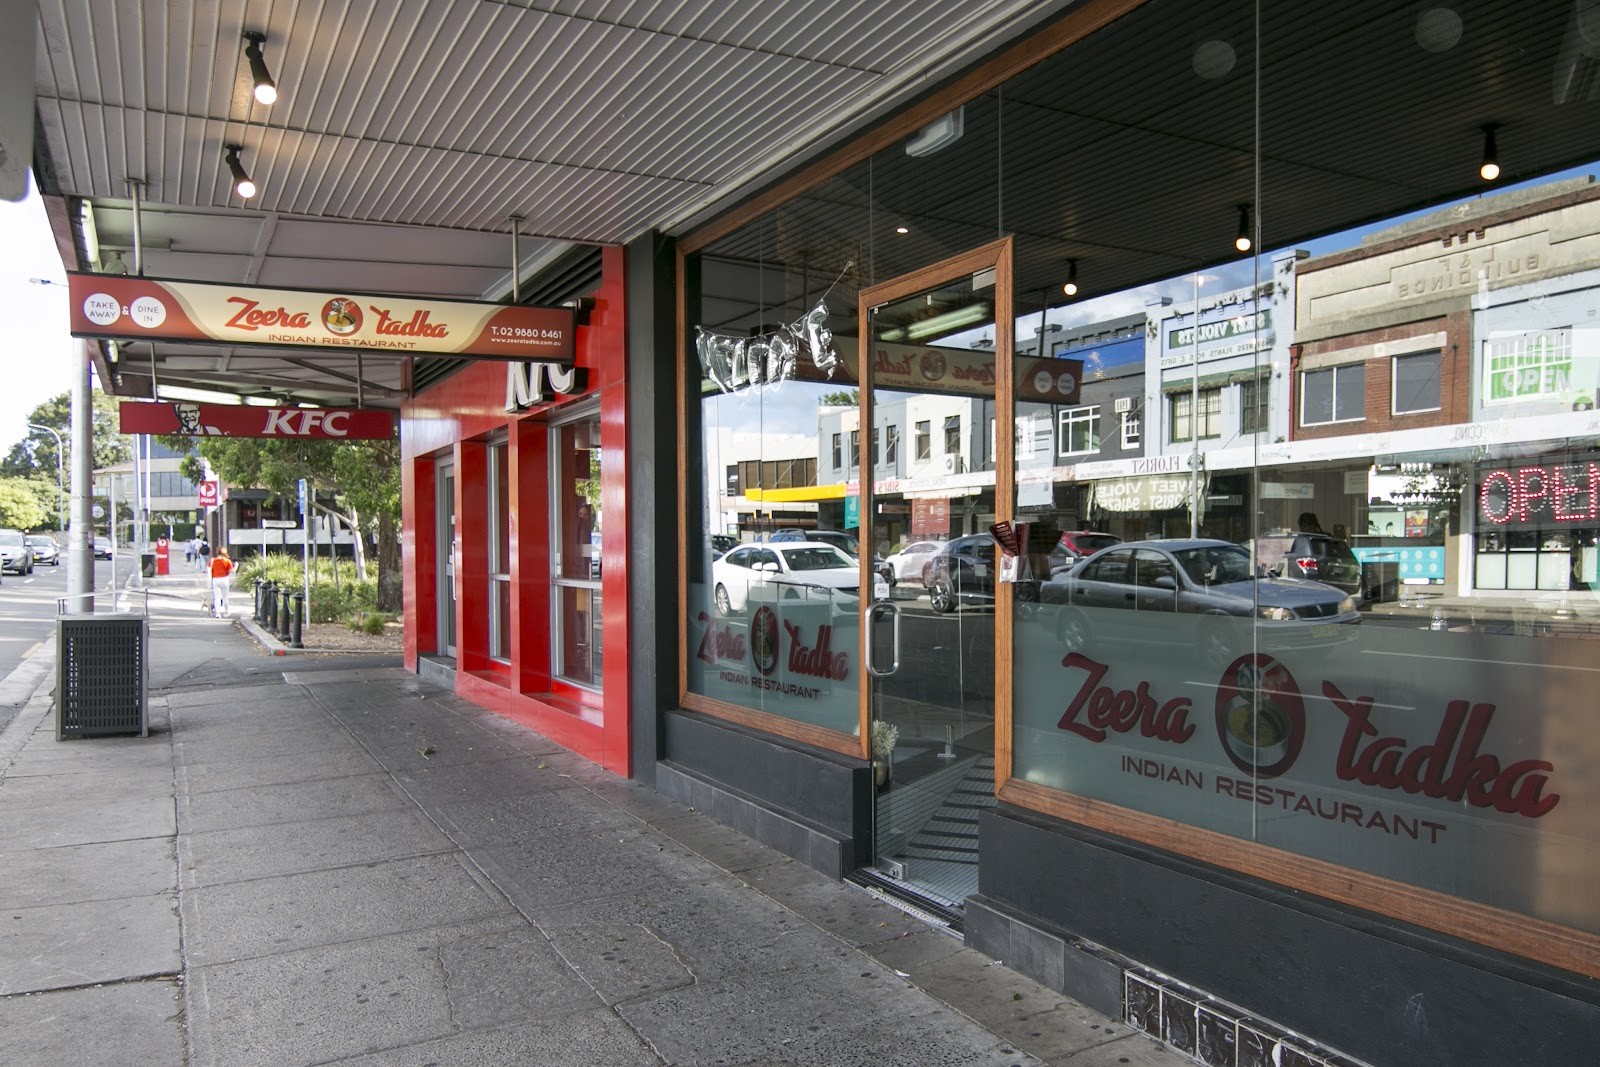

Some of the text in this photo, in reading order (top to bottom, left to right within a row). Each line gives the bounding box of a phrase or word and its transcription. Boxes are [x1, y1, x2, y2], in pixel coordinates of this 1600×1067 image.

[89, 311, 116, 319] AWAY
[90, 301, 114, 309] TAKE
[122, 305, 129, 316] &
[137, 305, 159, 314] DINE
[224, 296, 312, 332] Zeera
[268, 333, 416, 349] INDIAN RESTAURANT
[491, 326, 562, 339] T. 02 9880 8461
[1502, 369, 1572, 393] OPEN
[262, 409, 350, 436] KFC
[696, 611, 745, 665] Zeera
[719, 670, 820, 701] INDIAN RESTAURANT
[1056, 651, 1197, 744] Zeera
[1121, 754, 1448, 845] INDIAN RESTAURANT
